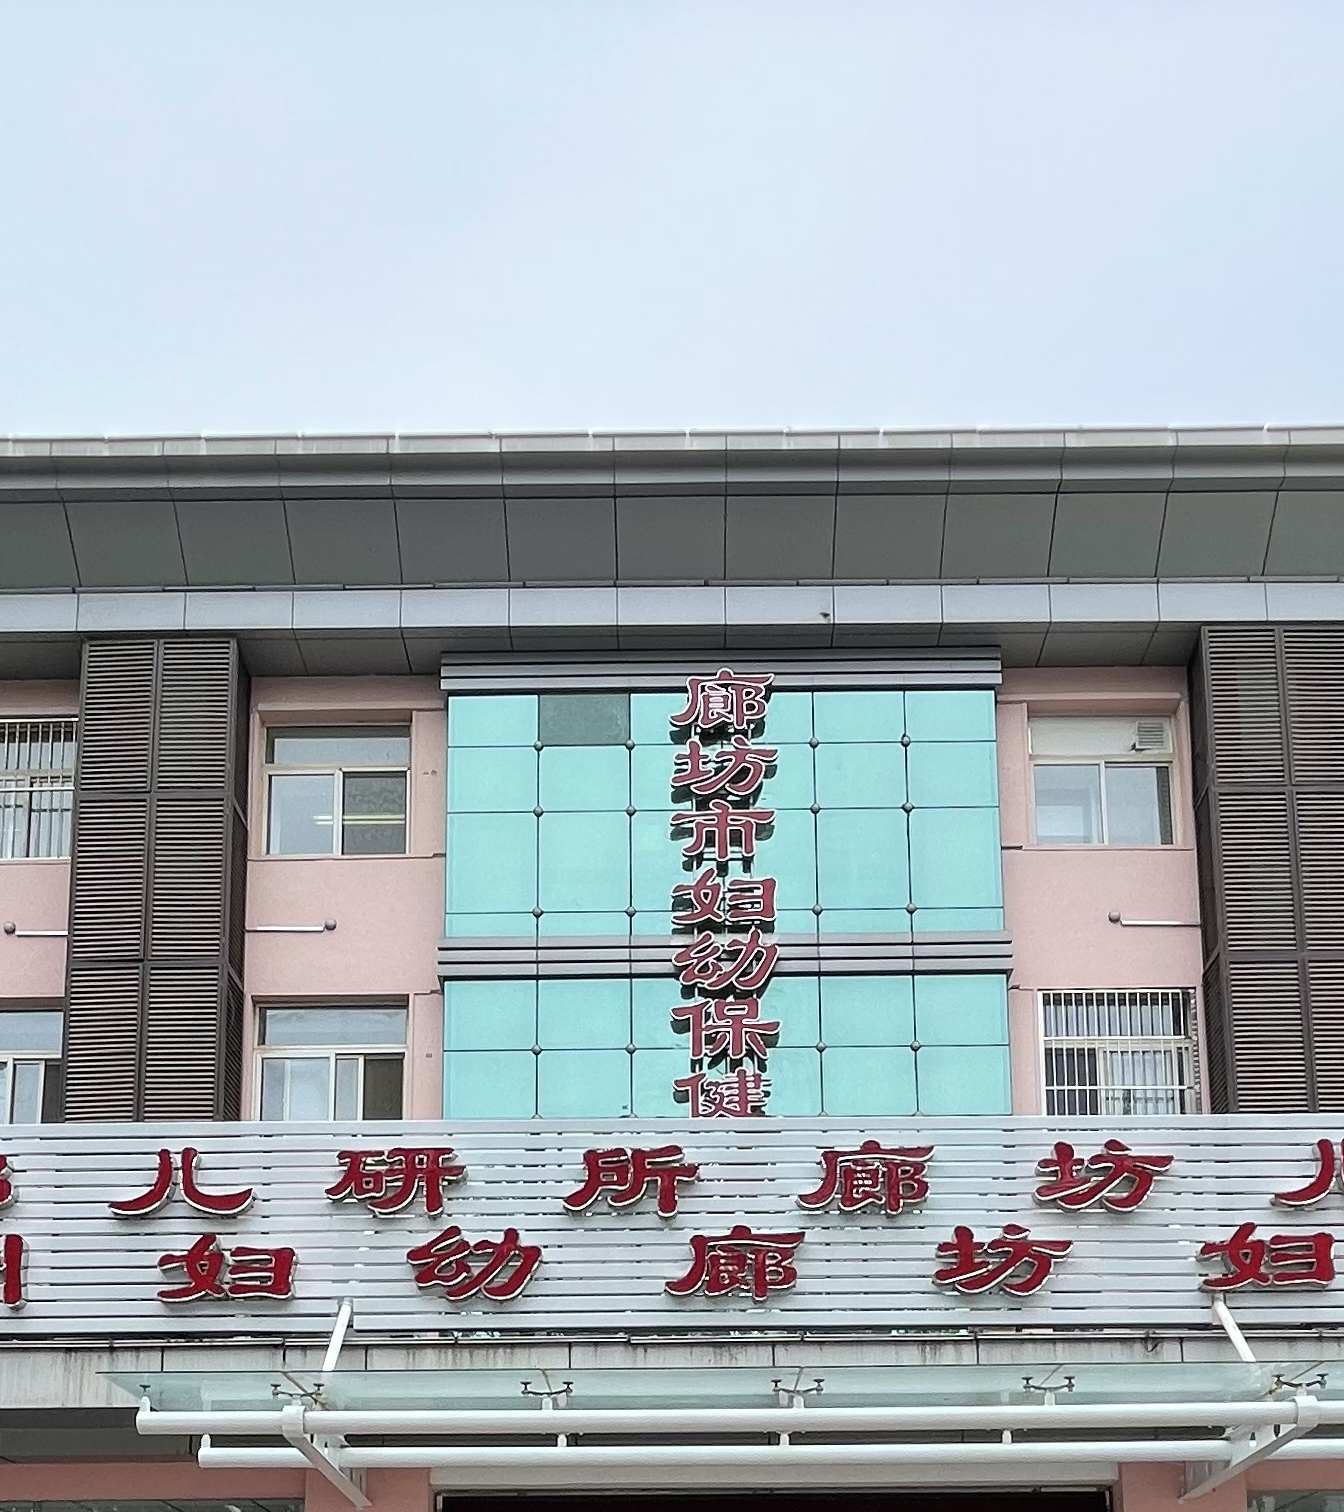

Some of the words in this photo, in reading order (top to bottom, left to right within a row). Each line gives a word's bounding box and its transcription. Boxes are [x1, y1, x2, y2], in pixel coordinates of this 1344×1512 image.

[669, 667, 780, 1118] 廊坊市妇幼保健
